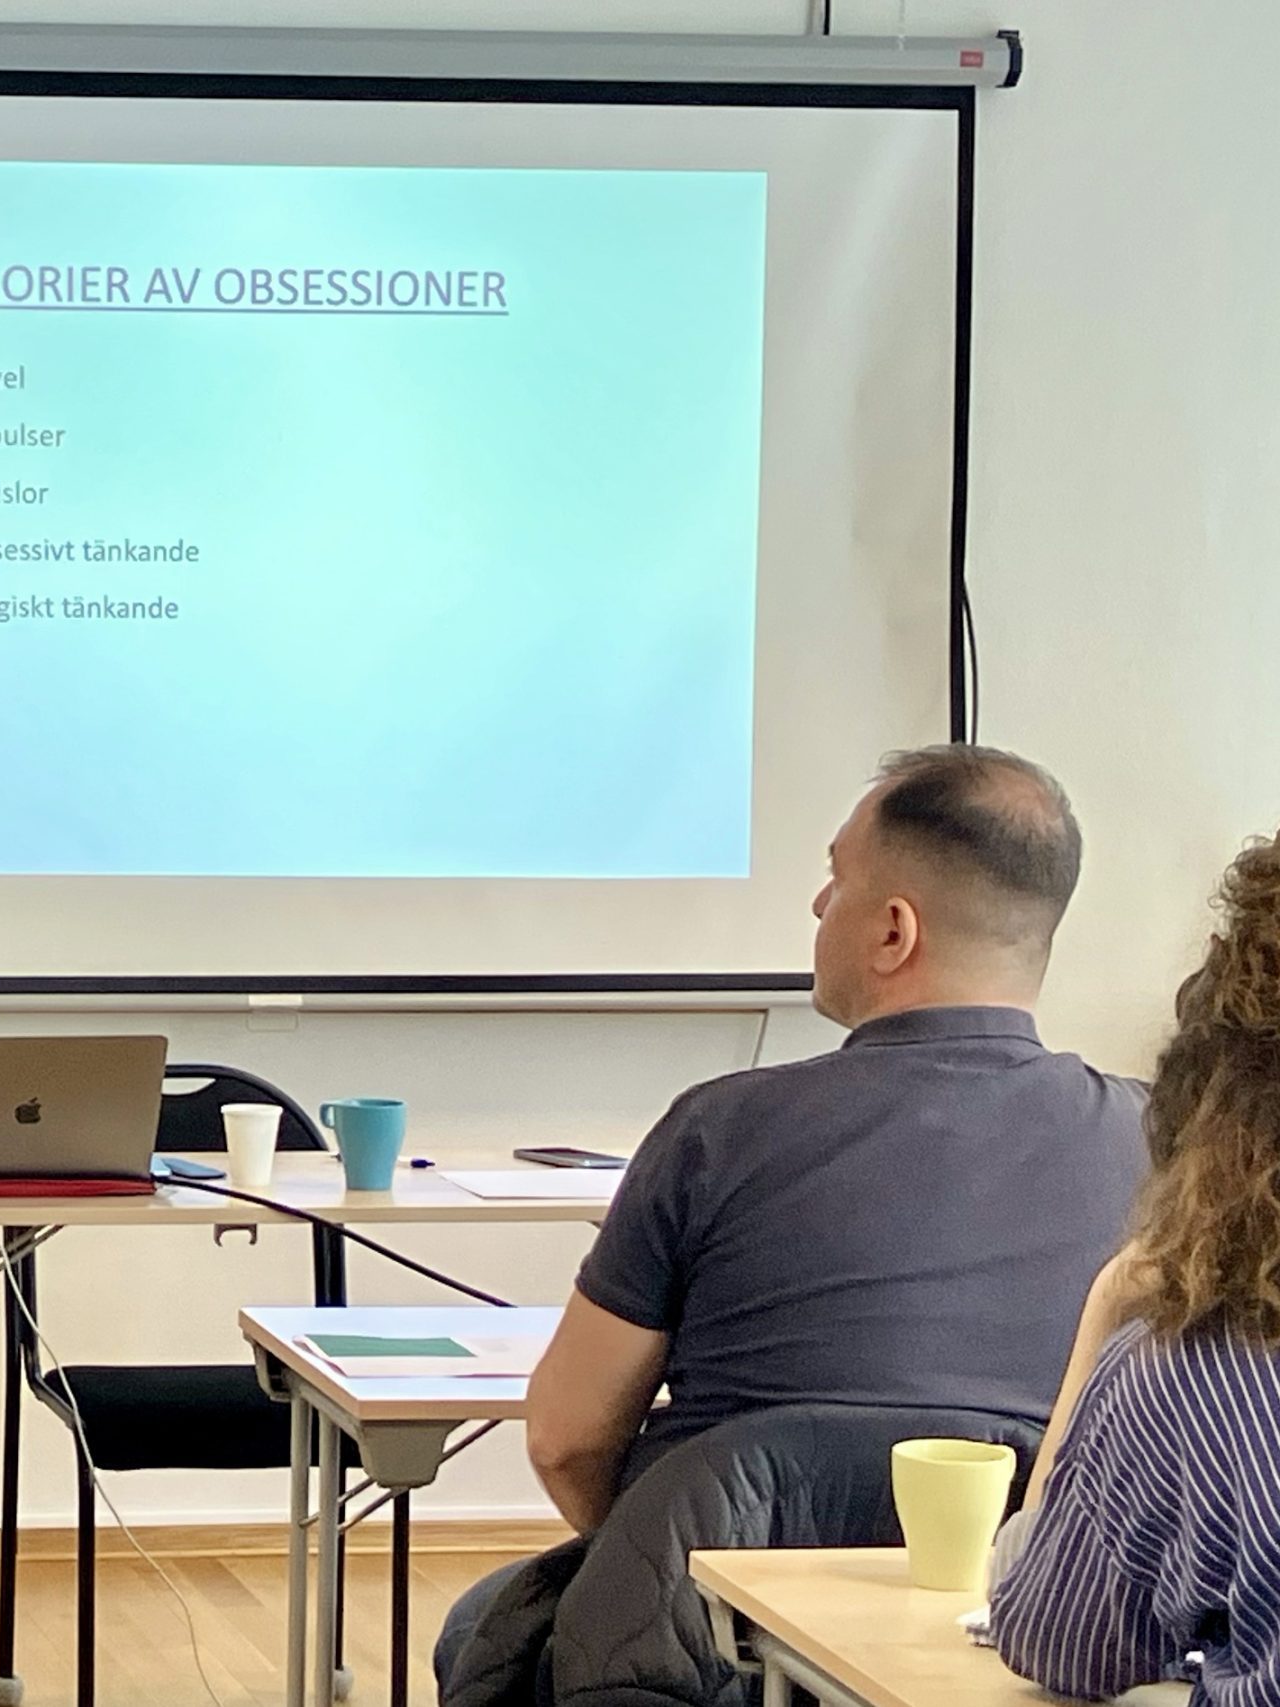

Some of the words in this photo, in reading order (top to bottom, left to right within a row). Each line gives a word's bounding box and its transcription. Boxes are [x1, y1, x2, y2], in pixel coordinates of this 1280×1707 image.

[143, 267, 200, 304] AV
[214, 268, 507, 307] OBSESSIONER
[82, 539, 200, 562] tänkande
[62, 596, 179, 619] tänkande
